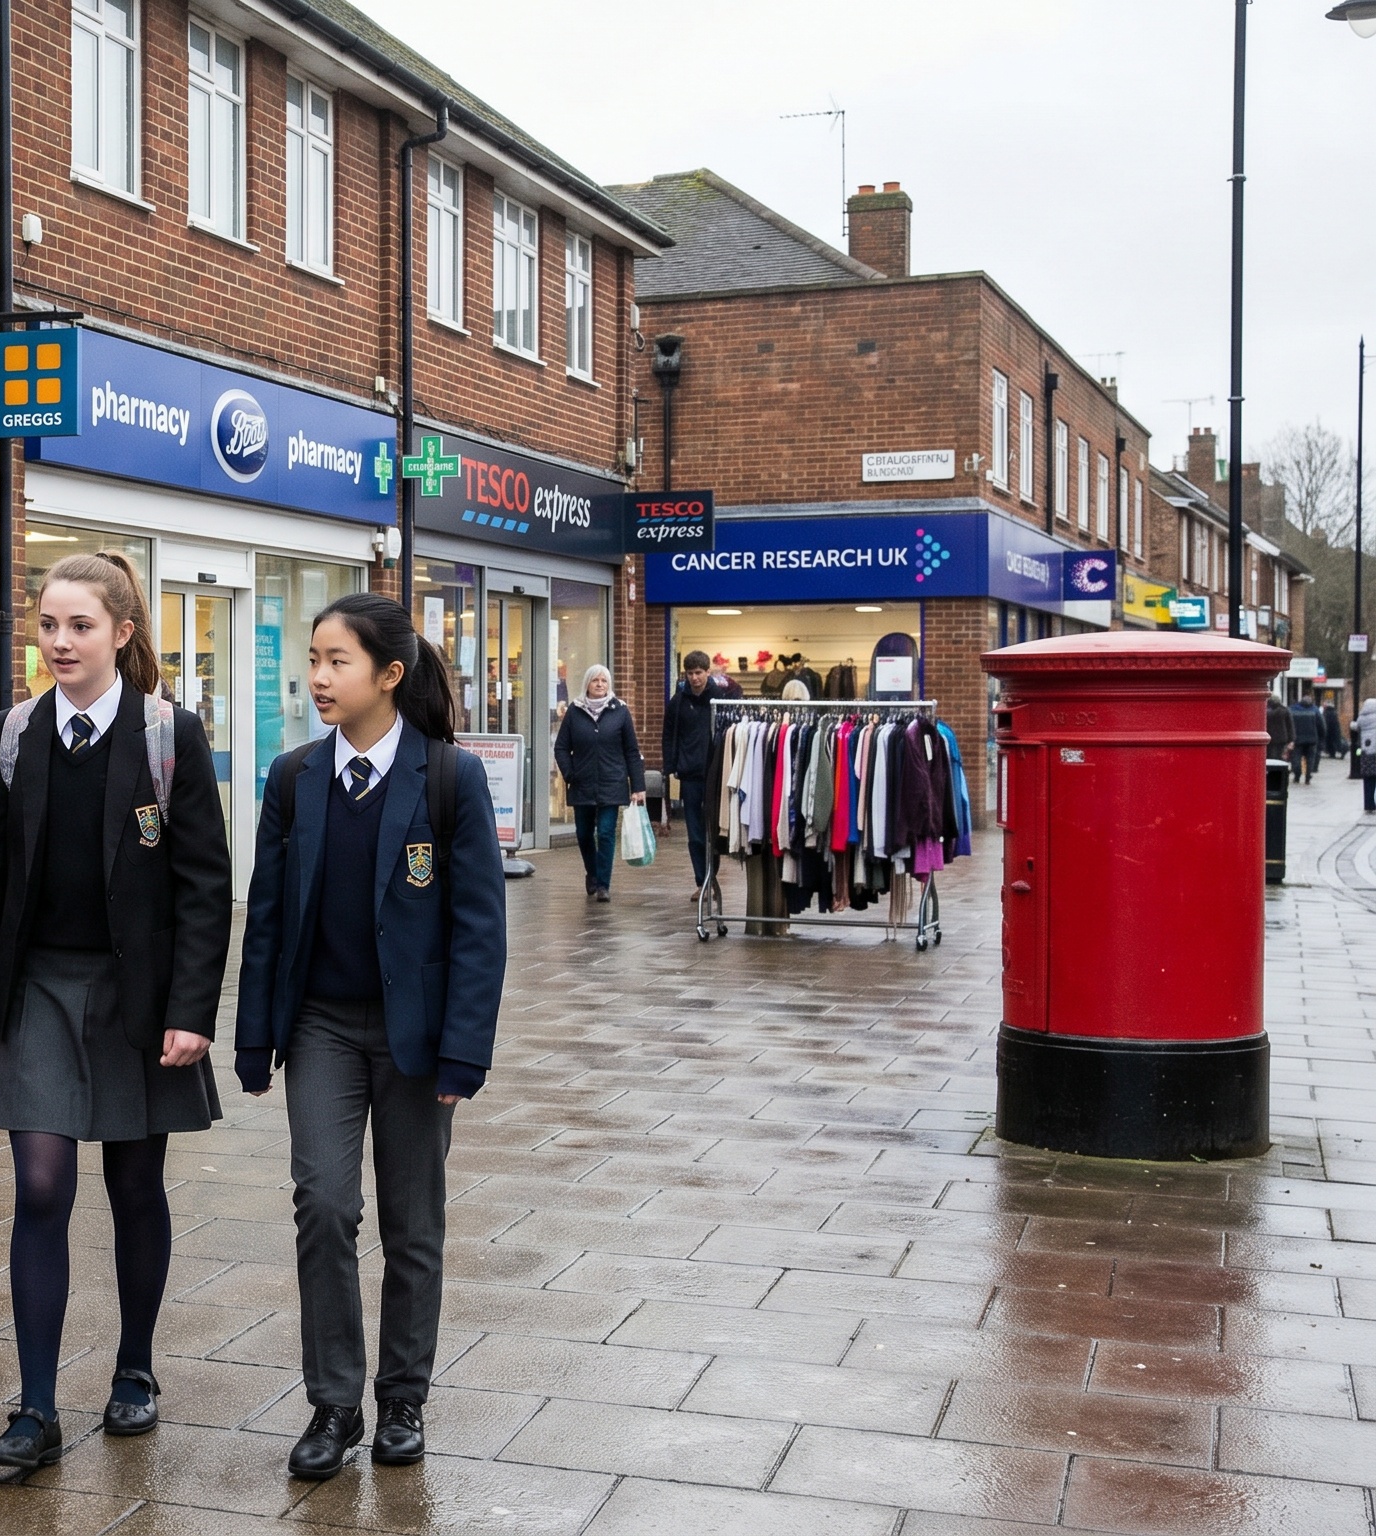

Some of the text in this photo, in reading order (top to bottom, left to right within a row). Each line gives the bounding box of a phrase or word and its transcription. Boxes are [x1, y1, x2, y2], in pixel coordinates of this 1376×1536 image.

[2, 412, 62, 428] GREGGS
[91, 380, 191, 446] pharmacy
[287, 430, 363, 484] pharmacy
[461, 456, 530, 513] TESCO
[534, 484, 592, 533] express
[636, 501, 704, 517] TESCO
[636, 524, 704, 542] express
[671, 547, 908, 571] CANCER RESEARCH UK
